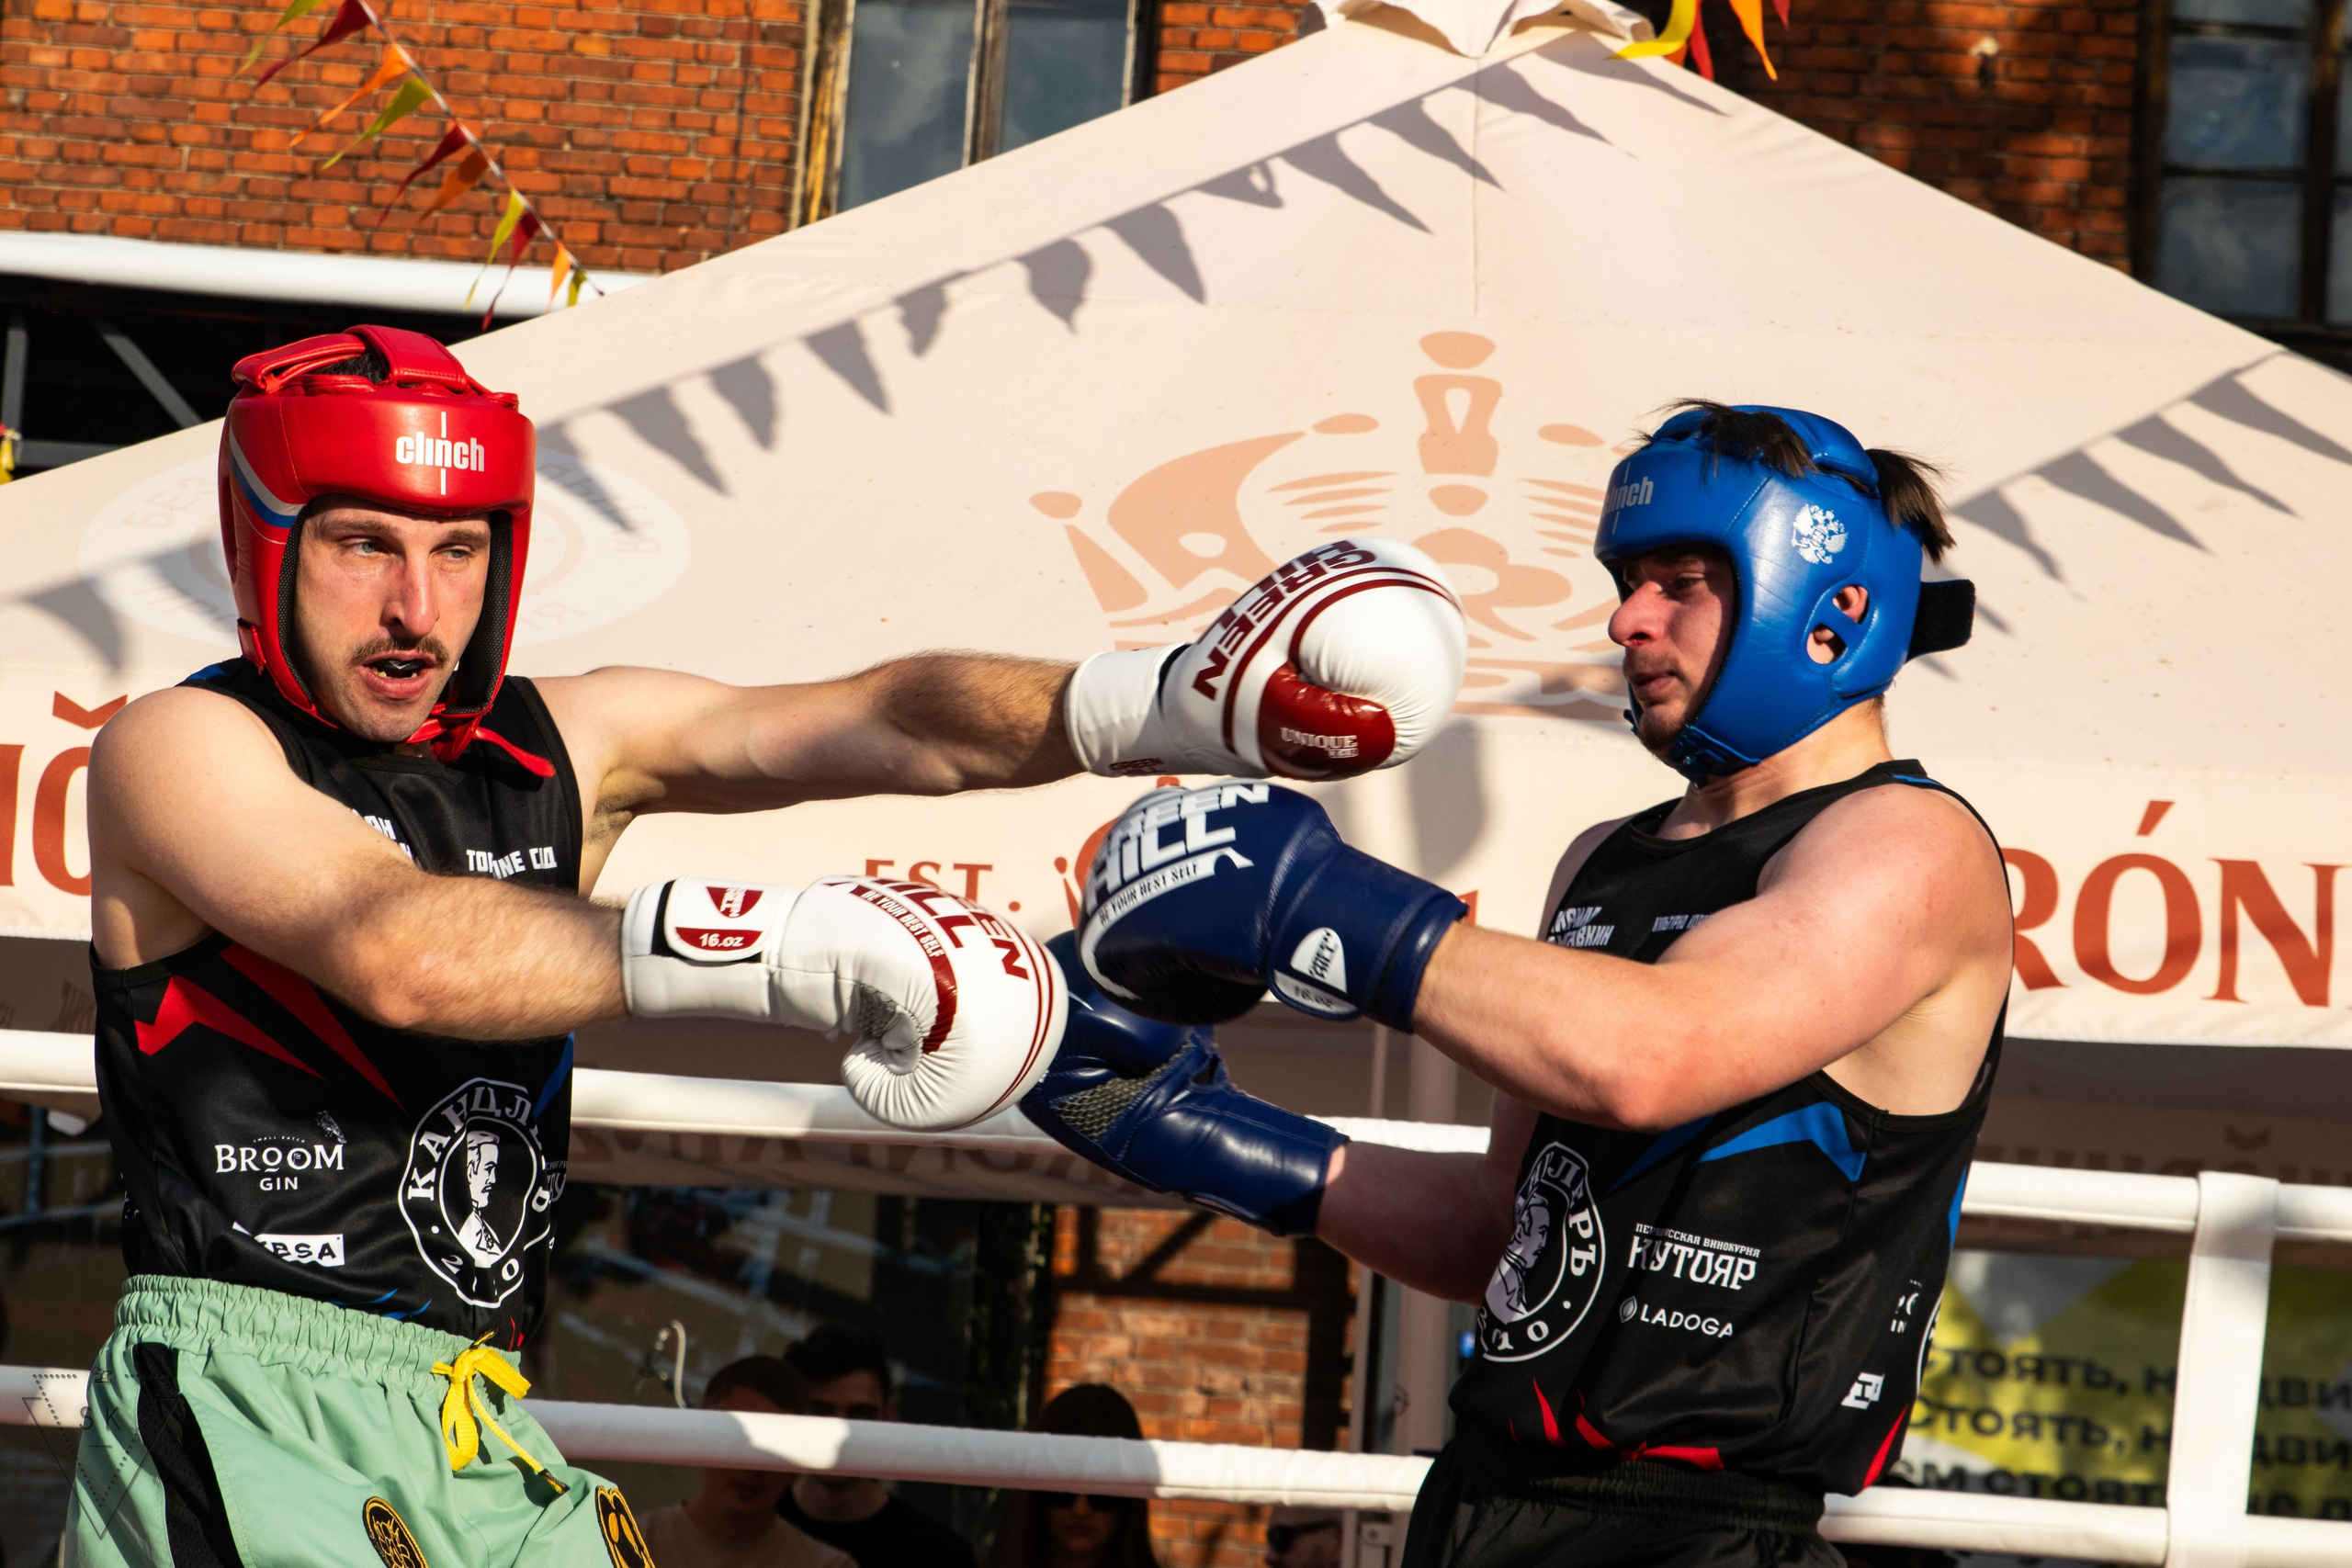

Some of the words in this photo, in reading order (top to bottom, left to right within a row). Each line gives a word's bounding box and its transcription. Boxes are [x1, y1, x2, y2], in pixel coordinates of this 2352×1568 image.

[396, 431, 485, 472] clinch
[1192, 549, 1376, 702] GREEN
[1280, 727, 1359, 749] UNIQUE
[1111, 887, 1138, 917] YOUR
[1138, 874, 1168, 899] BEST
[1170, 860, 1201, 886] SELF
[876, 897, 903, 919] YOUR
[899, 911, 927, 937] BEST
[919, 932, 945, 958] SELF
[214, 1144, 345, 1173] BROOM
[259, 1177, 299, 1191] GIN
[263, 1240, 337, 1260] BSA
[1702, 1237, 1761, 1258] ВИНОКУРНЯ
[1640, 1303, 1734, 1338] LADOGA
